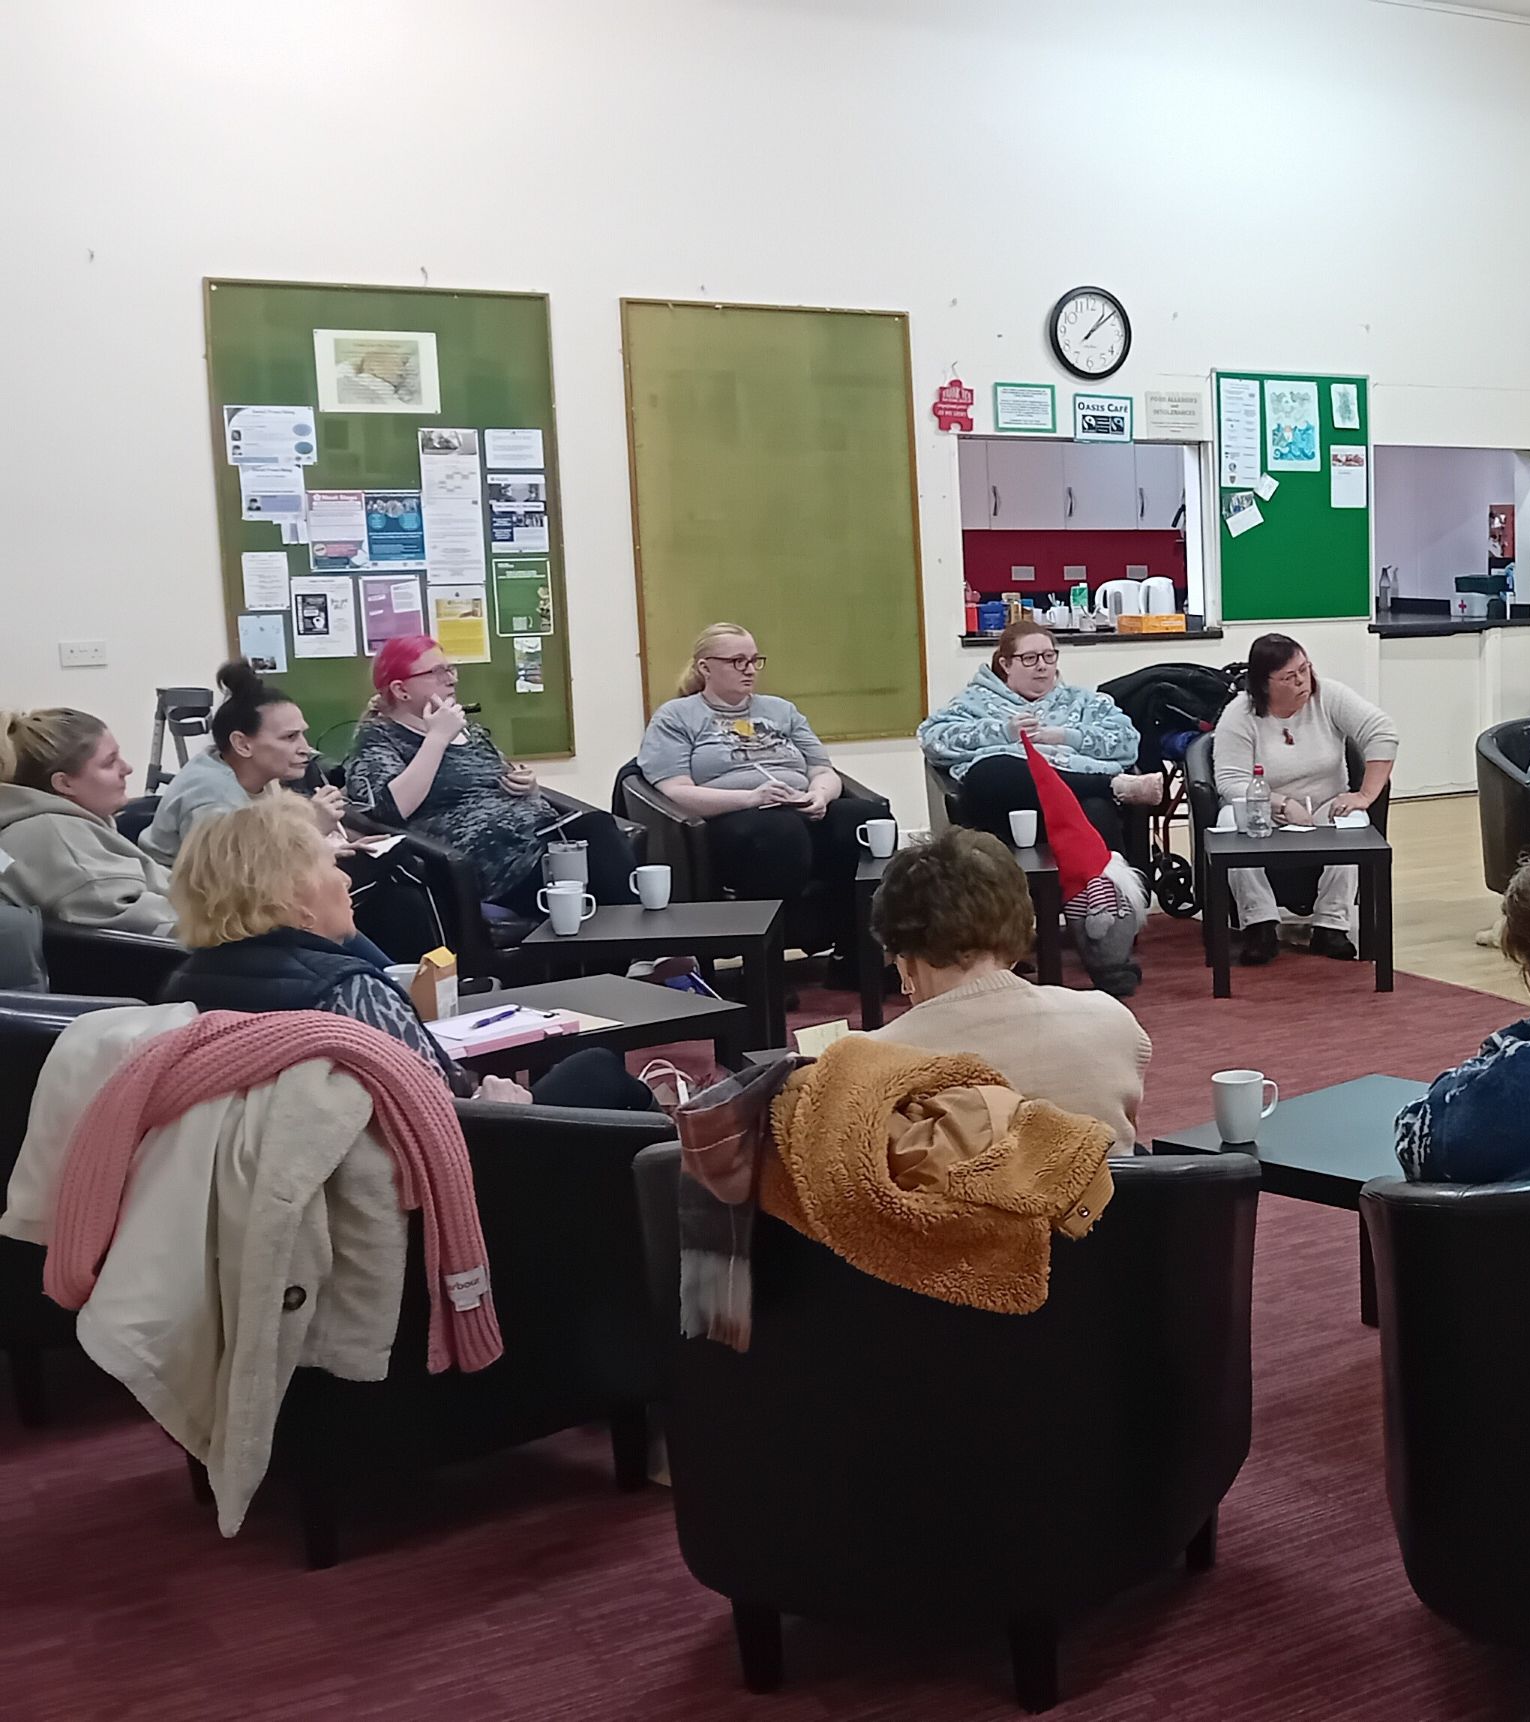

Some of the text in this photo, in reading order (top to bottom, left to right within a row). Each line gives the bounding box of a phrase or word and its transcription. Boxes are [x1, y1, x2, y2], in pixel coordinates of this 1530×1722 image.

[1075, 300, 1083, 313] 11
[1086, 296, 1096, 312] 12
[1064, 311, 1077, 325] 10
